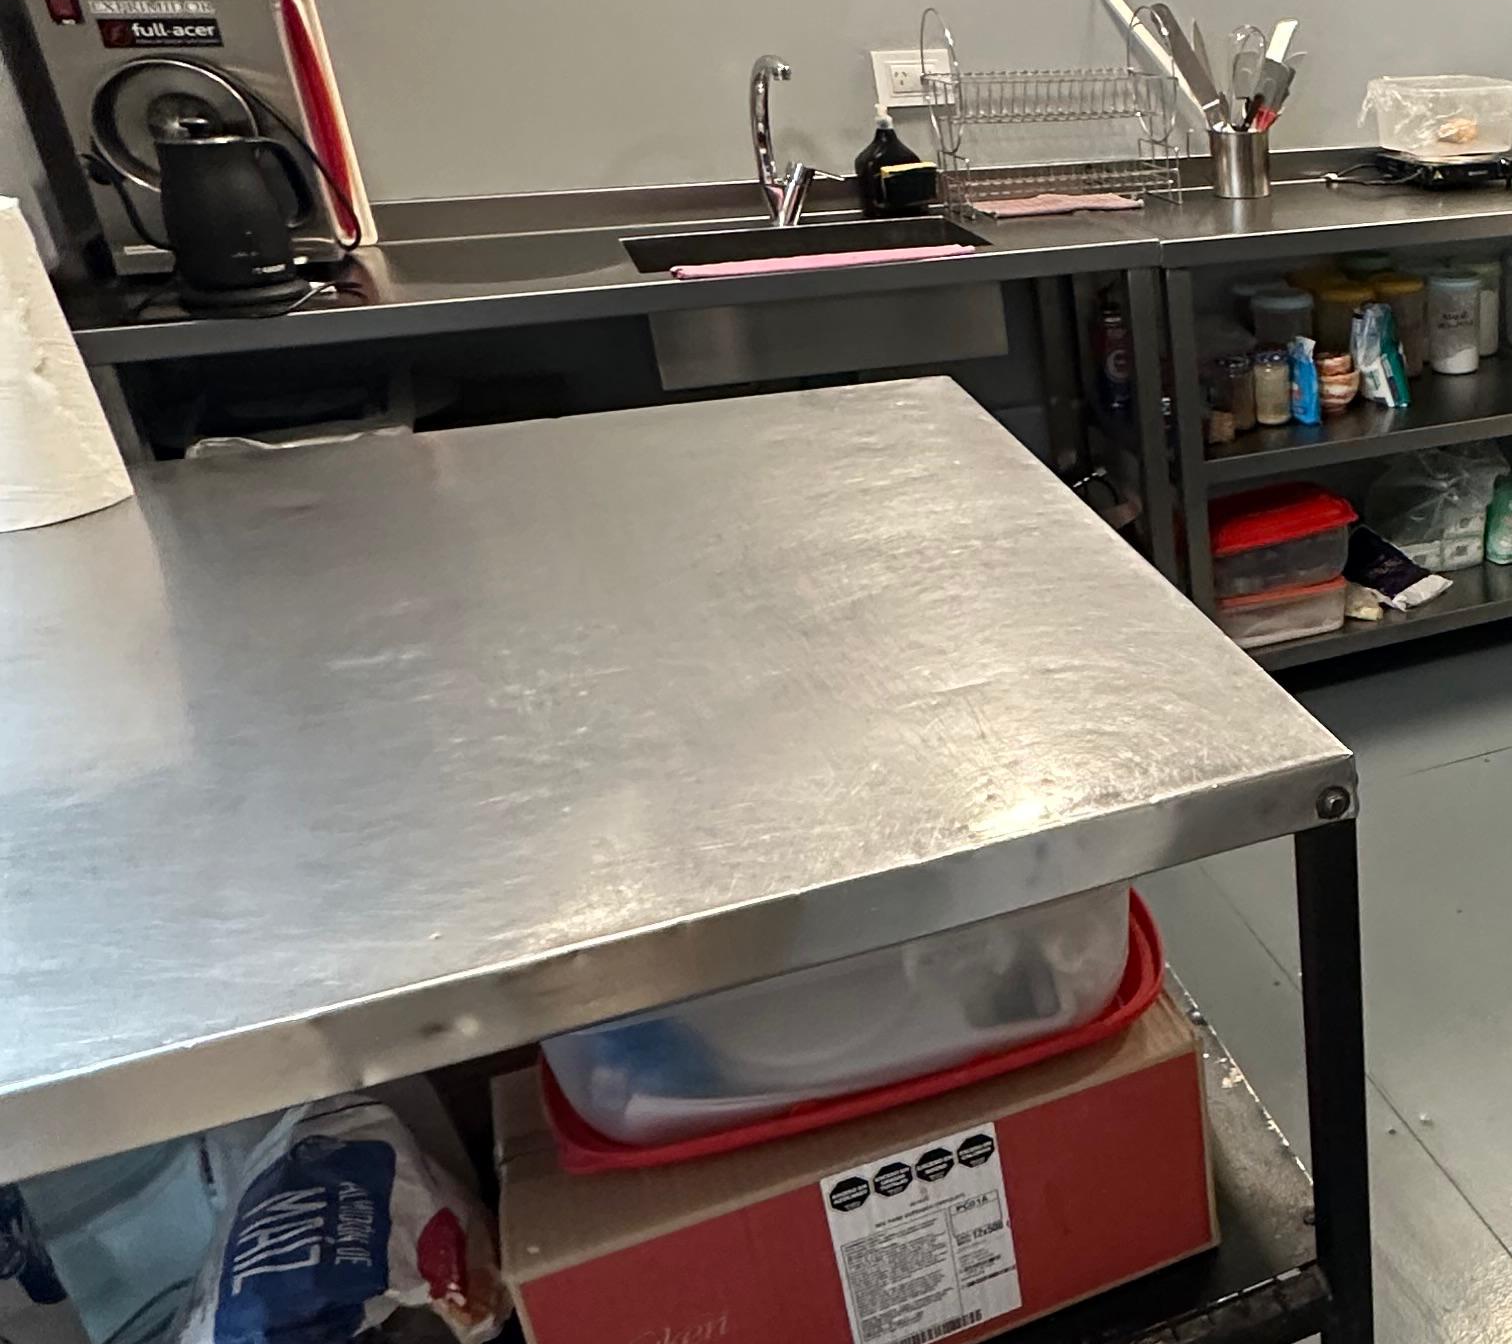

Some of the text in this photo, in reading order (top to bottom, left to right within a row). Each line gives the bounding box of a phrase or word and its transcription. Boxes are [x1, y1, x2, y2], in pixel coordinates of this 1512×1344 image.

[131, 22, 216, 37] full-acer
[231, 1186, 336, 1296] MAÍZ
[335, 1246, 373, 1268] DE
